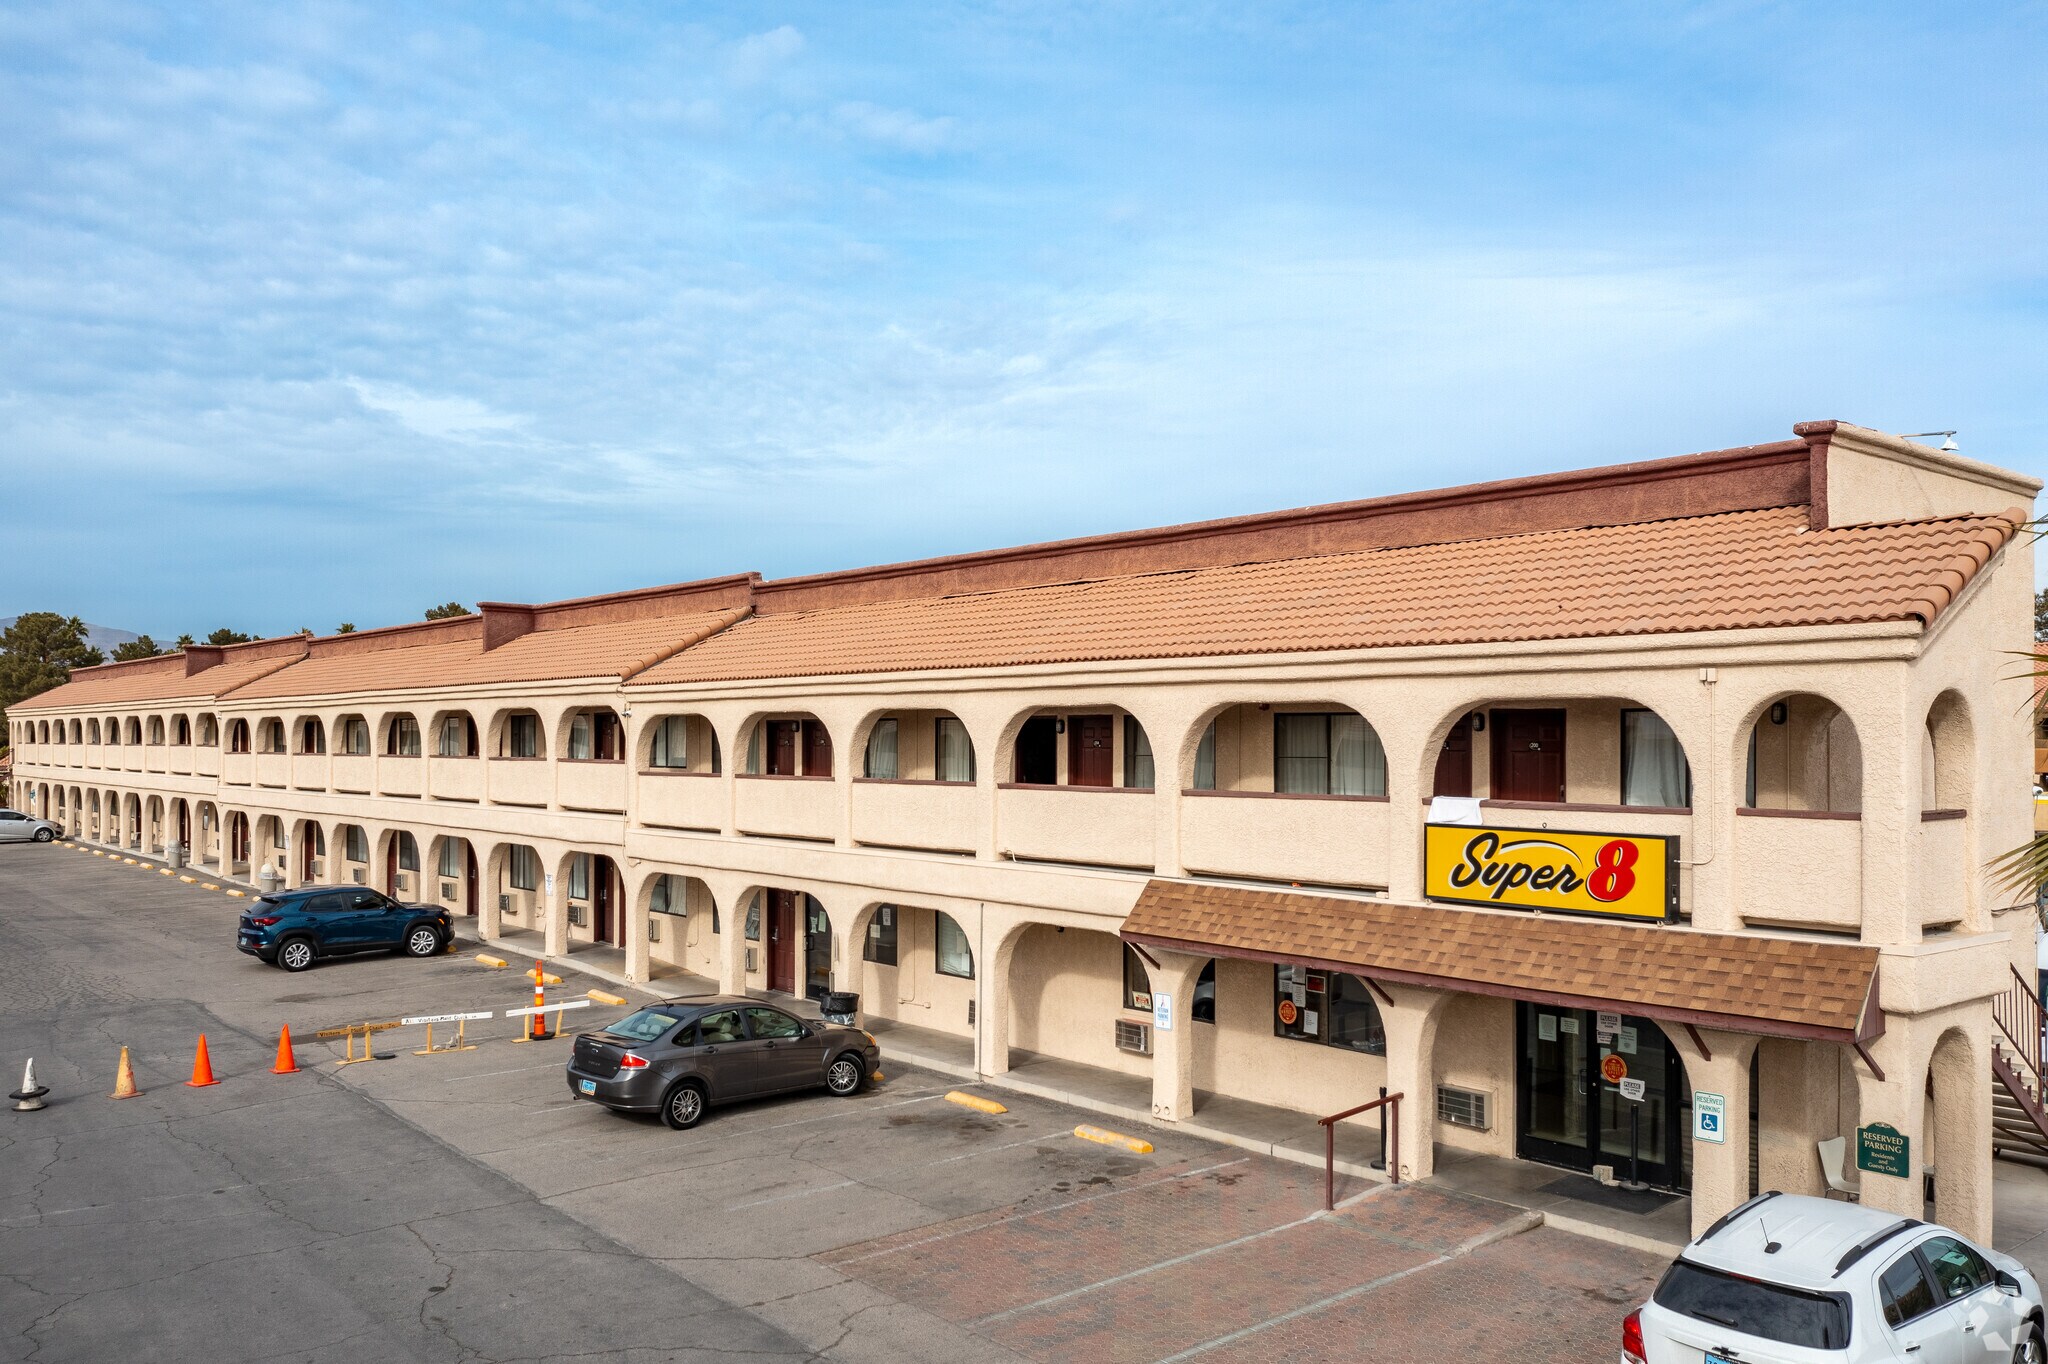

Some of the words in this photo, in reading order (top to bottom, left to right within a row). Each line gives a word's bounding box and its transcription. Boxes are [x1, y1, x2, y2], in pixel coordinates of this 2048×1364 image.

[1448, 832, 1584, 899] Super
[1585, 839, 1639, 903] 8
[1697, 1096, 1722, 1105] RESERVED
[1699, 1104, 1720, 1113] PARKING
[1863, 1132, 1903, 1145] RESERVED
[1864, 1140, 1902, 1153] PARKING
[1871, 1152, 1895, 1160] Residents
[1867, 1162, 1885, 1170] Guests
[1886, 1165, 1898, 1173] Only
